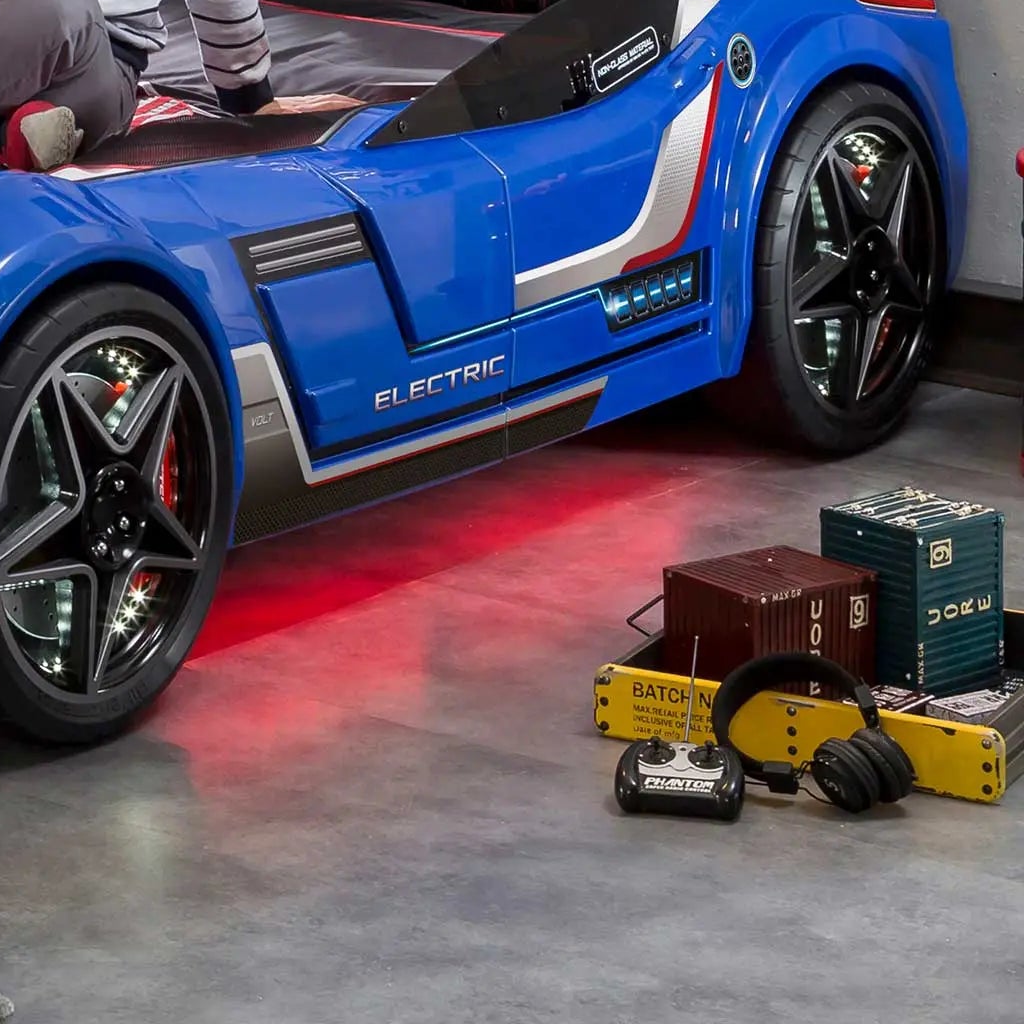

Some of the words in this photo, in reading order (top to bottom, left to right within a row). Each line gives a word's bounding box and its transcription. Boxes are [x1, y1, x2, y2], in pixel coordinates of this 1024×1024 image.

[375, 354, 505, 413] ELECTRIC
[854, 599, 865, 624] 9
[632, 681, 691, 704] BATCH
[643, 777, 716, 791] PHANTOM
